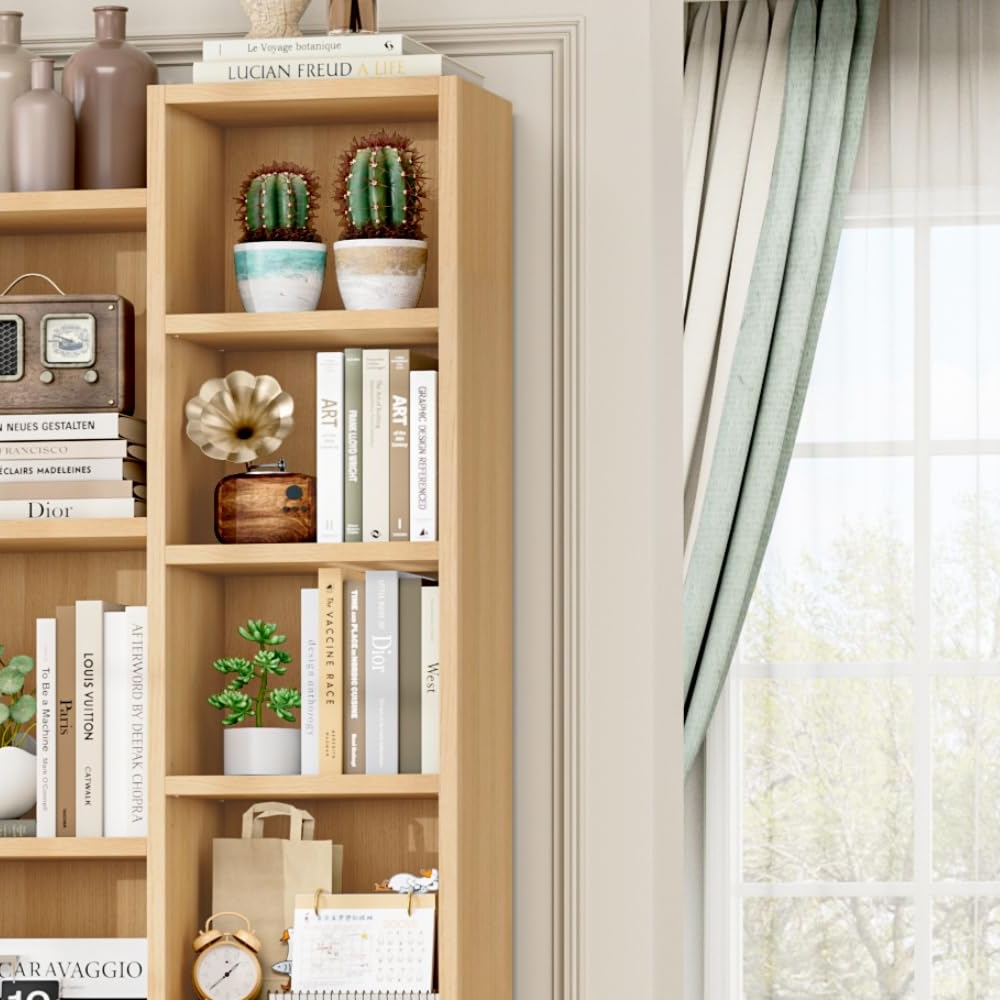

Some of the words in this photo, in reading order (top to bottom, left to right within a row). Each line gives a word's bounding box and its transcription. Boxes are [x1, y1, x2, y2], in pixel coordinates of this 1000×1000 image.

[247, 43, 258, 53] Le
[260, 43, 294, 53] Voyage
[296, 41, 342, 52] botanique
[228, 64, 291, 80] LUCIAN
[298, 62, 353, 78] FREUD
[357, 63, 369, 76] A
[375, 61, 406, 75] LIFE
[321, 398, 338, 428] ART
[391, 394, 408, 426] ART
[418, 386, 427, 422] GRAPHIC
[6, 422, 39, 432] NEUES
[41, 421, 95, 431] GESTALTEN
[418, 425, 427, 455] DESIGN
[37, 465, 92, 475] MADELEINES
[418, 456, 427, 511] REFERENCED
[28, 501, 73, 519] Dior
[325, 611, 335, 666] VACCINE
[371, 635, 392, 673] Dior
[41, 668, 51, 680] To
[83, 653, 94, 688] LOUIS
[131, 623, 143, 701] AFTERWORD
[427, 662, 439, 693] West
[41, 682, 51, 696] Be
[325, 673, 335, 705] RACE
[59, 700, 73, 736] Paris
[83, 692, 94, 741] VUITTON
[131, 704, 143, 719] BY
[41, 708, 51, 752] Machine
[131, 723, 143, 769] DEEPAK
[84, 766, 92, 806] CATWALK
[131, 773, 143, 823] CHOPRA
